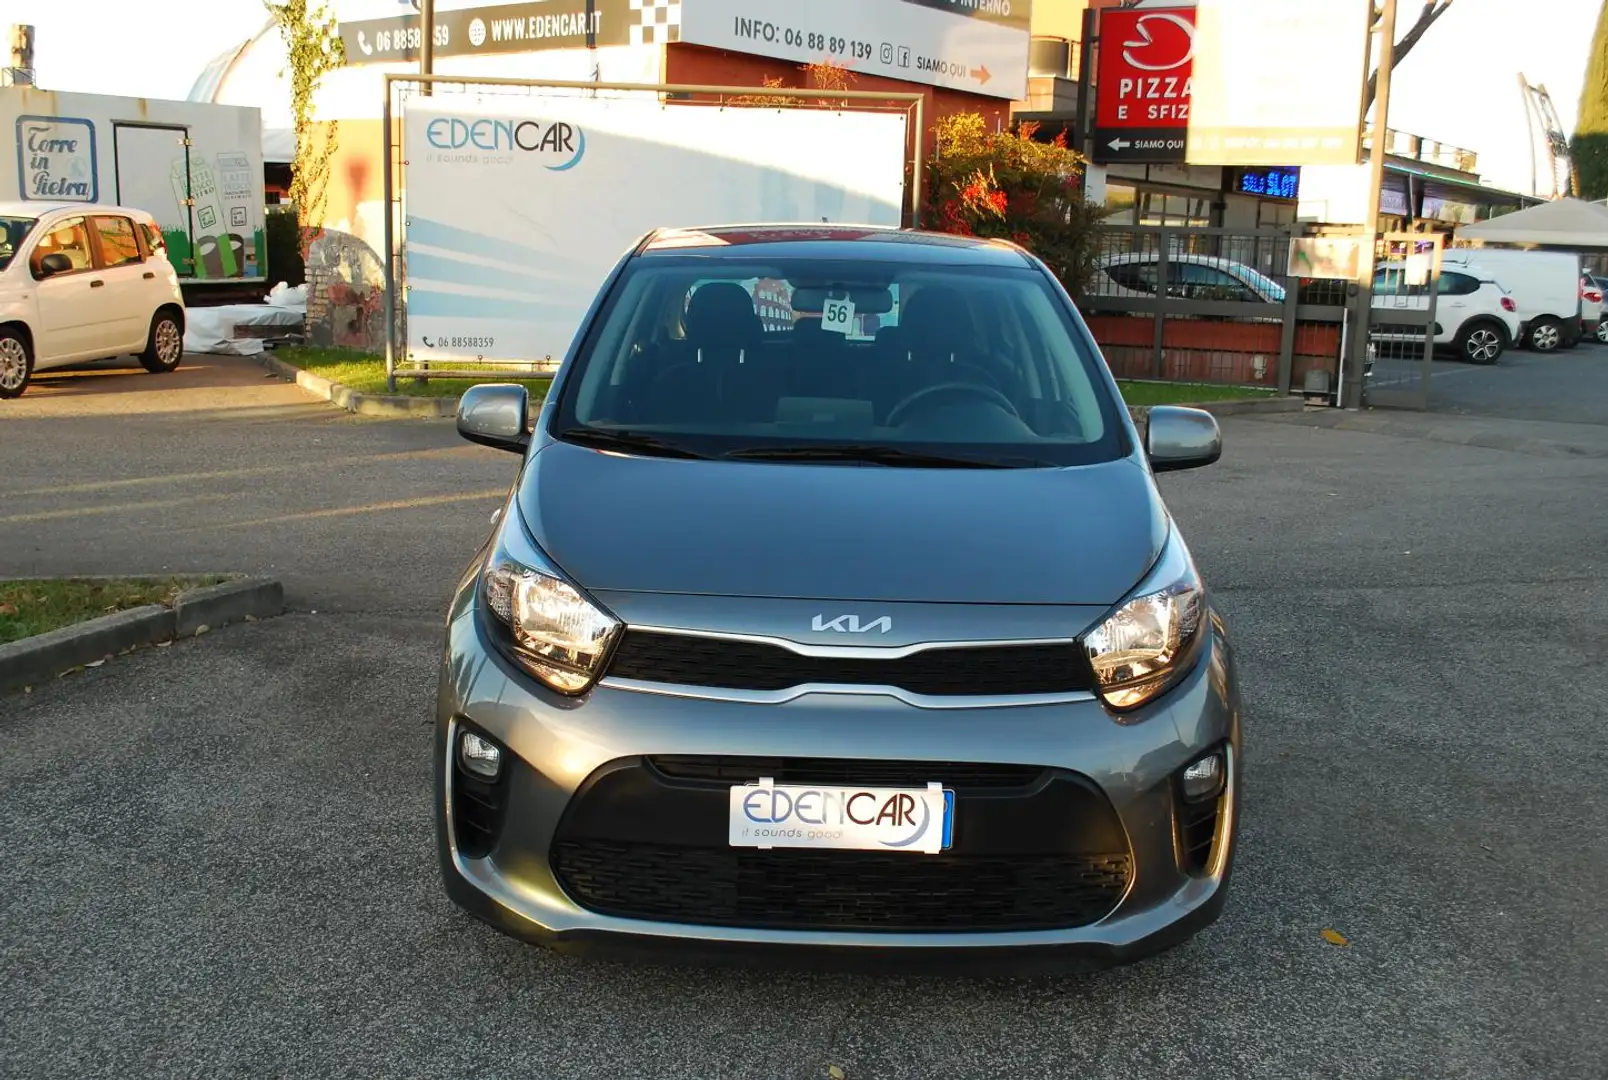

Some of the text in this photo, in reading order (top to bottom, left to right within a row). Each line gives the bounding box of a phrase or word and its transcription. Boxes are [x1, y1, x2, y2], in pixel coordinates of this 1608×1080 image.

[376, 24, 449, 52] 06 885859
[491, 10, 602, 42] WWW.EDENCAR.IT
[734, 16, 872, 60] INFO: 06 88 89 139
[916, 55, 967, 80] SIAMO QUI
[1119, 76, 1192, 99] PIZZA
[1118, 105, 1128, 119] E
[28, 126, 78, 153] Torre
[426, 117, 575, 153] EDENCAR
[1134, 140, 1165, 149] SIAMO
[1166, 140, 1184, 149] QUI
[30, 154, 49, 170] in
[827, 304, 848, 323] 56
[438, 337, 494, 348] 06 88588359
[743, 789, 917, 826] EDENCAR
[754, 828, 803, 838] sounds
